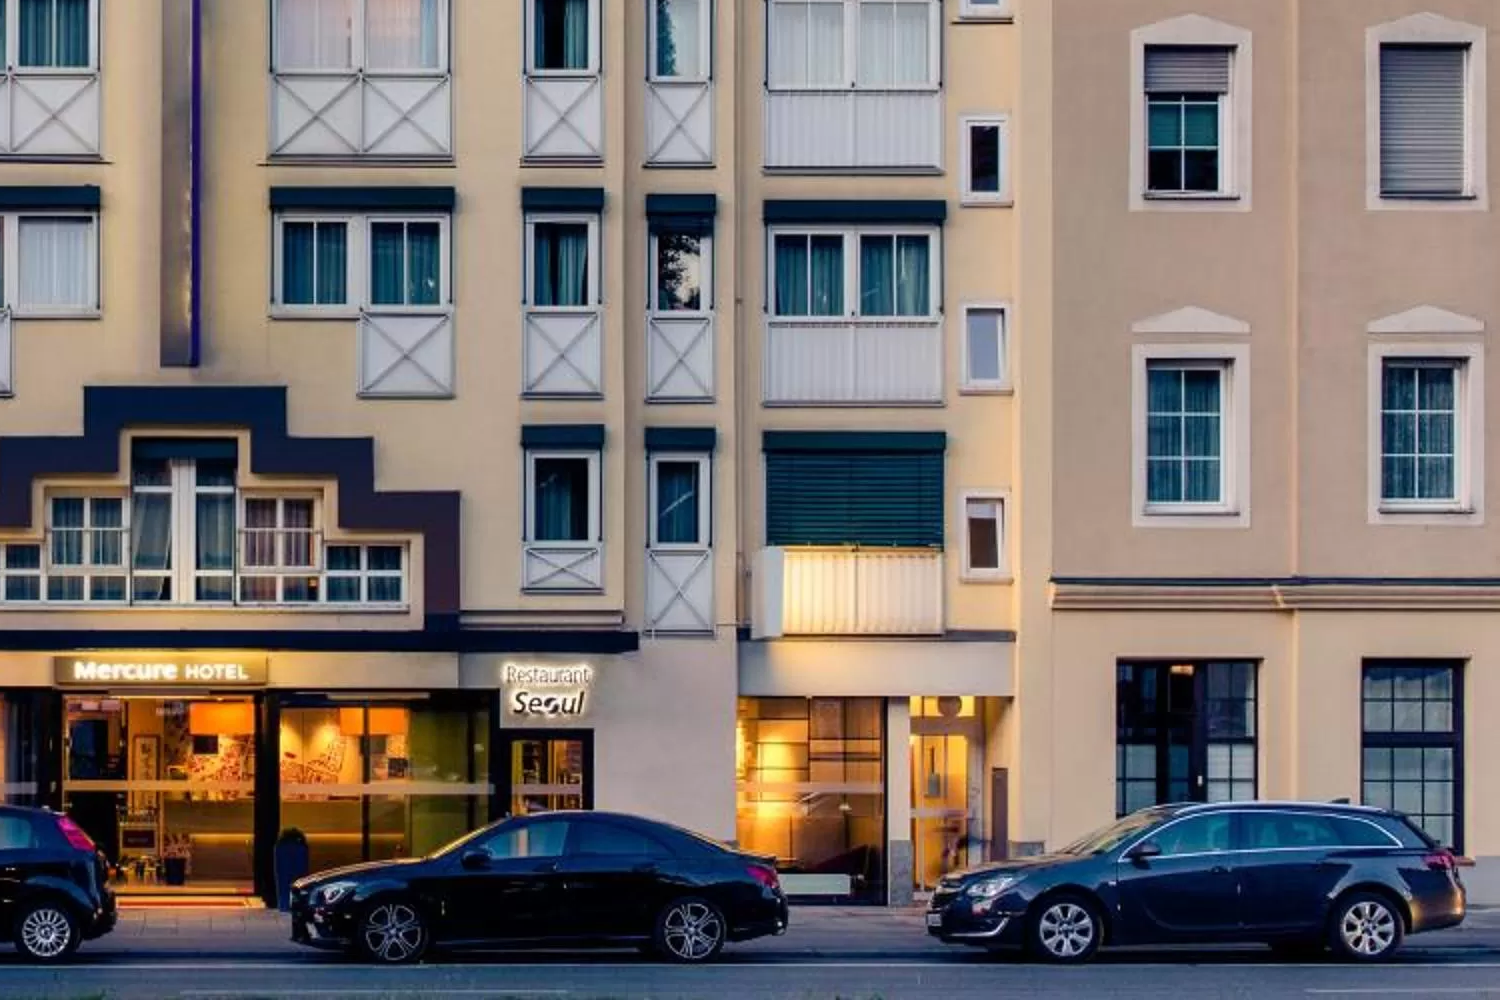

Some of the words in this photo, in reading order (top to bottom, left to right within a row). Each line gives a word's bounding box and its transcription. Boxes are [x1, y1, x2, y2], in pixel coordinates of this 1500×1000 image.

[74, 660, 178, 679] Mercure
[185, 663, 249, 679] HOTEL
[506, 665, 590, 683] Restaurant
[512, 690, 585, 714] Seoul
